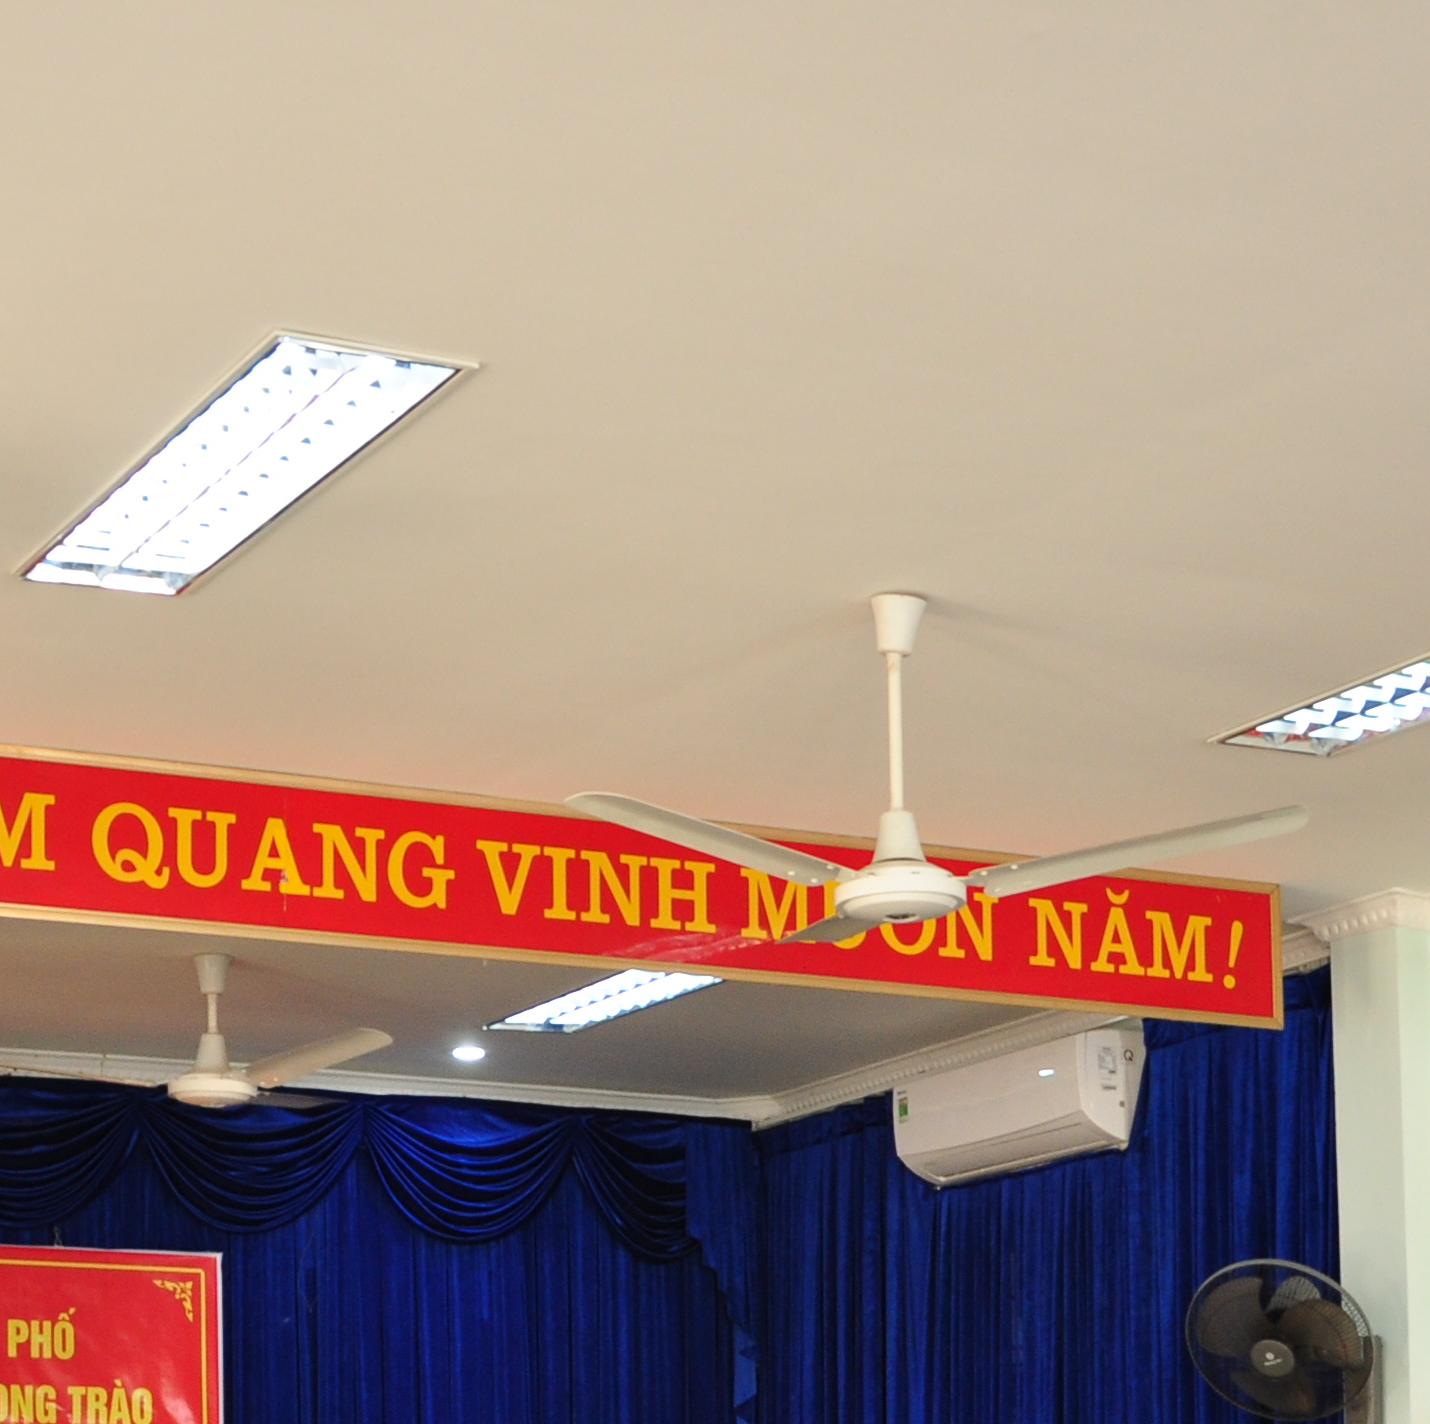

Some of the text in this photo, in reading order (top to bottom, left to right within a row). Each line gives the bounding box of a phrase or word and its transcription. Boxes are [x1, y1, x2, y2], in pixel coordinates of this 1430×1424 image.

[91, 802, 456, 909] QUANG
[476, 839, 717, 934] VINH
[1028, 888, 1244, 989] NĂM!
[7, 1306, 76, 1360] PHỐ
